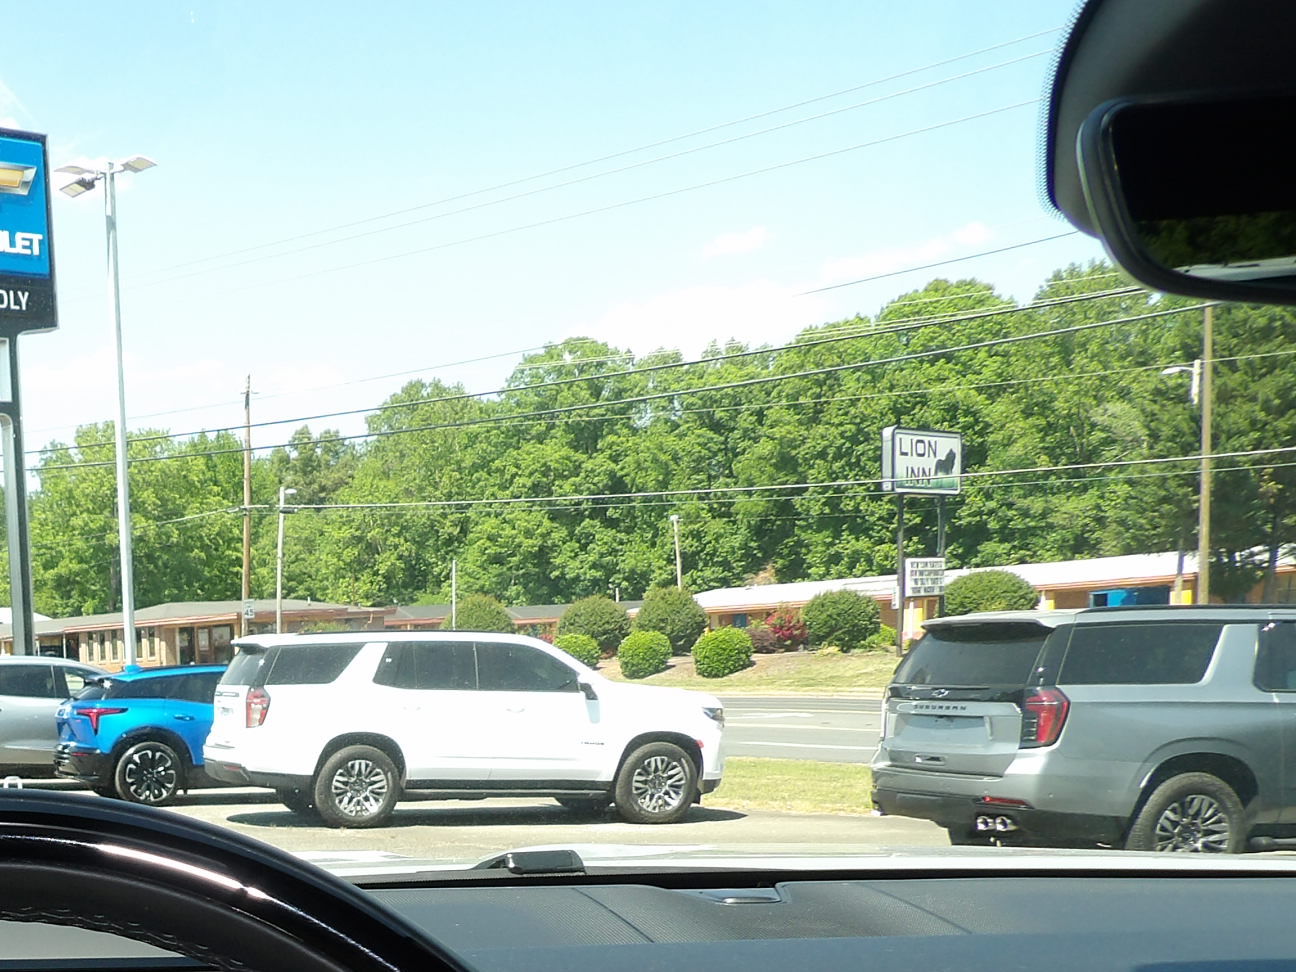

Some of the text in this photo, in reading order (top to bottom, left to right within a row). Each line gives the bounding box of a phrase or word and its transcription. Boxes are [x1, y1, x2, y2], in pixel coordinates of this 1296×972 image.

[898, 437, 938, 458] LION
[905, 466, 932, 486] INN
[245, 608, 255, 617] 45
